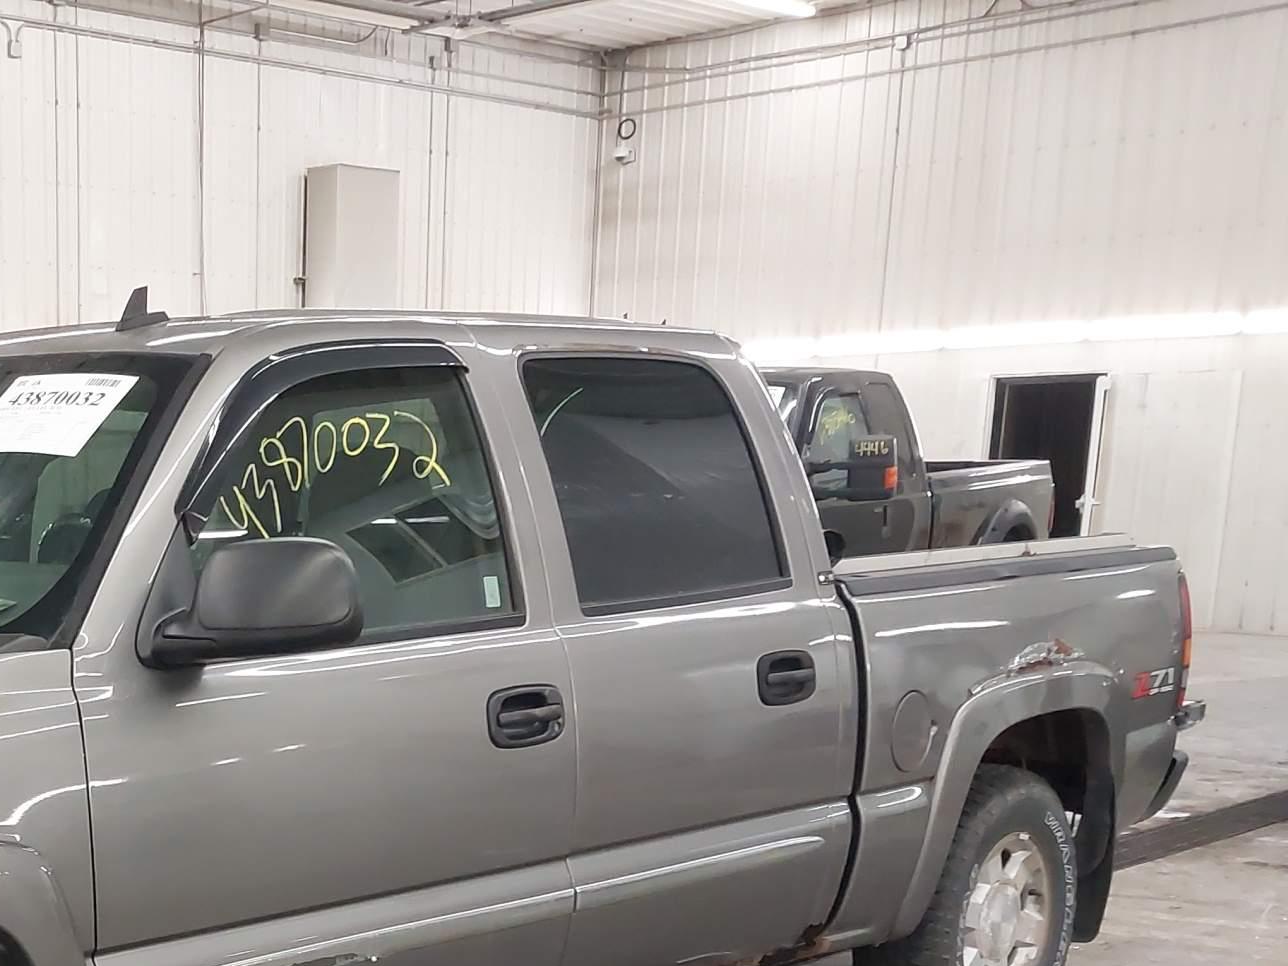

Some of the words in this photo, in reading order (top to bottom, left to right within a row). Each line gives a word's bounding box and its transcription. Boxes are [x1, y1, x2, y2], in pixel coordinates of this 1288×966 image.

[8, 391, 107, 406] 43870032
[220, 410, 451, 540] 43870032
[1131, 667, 1175, 699] Z71
